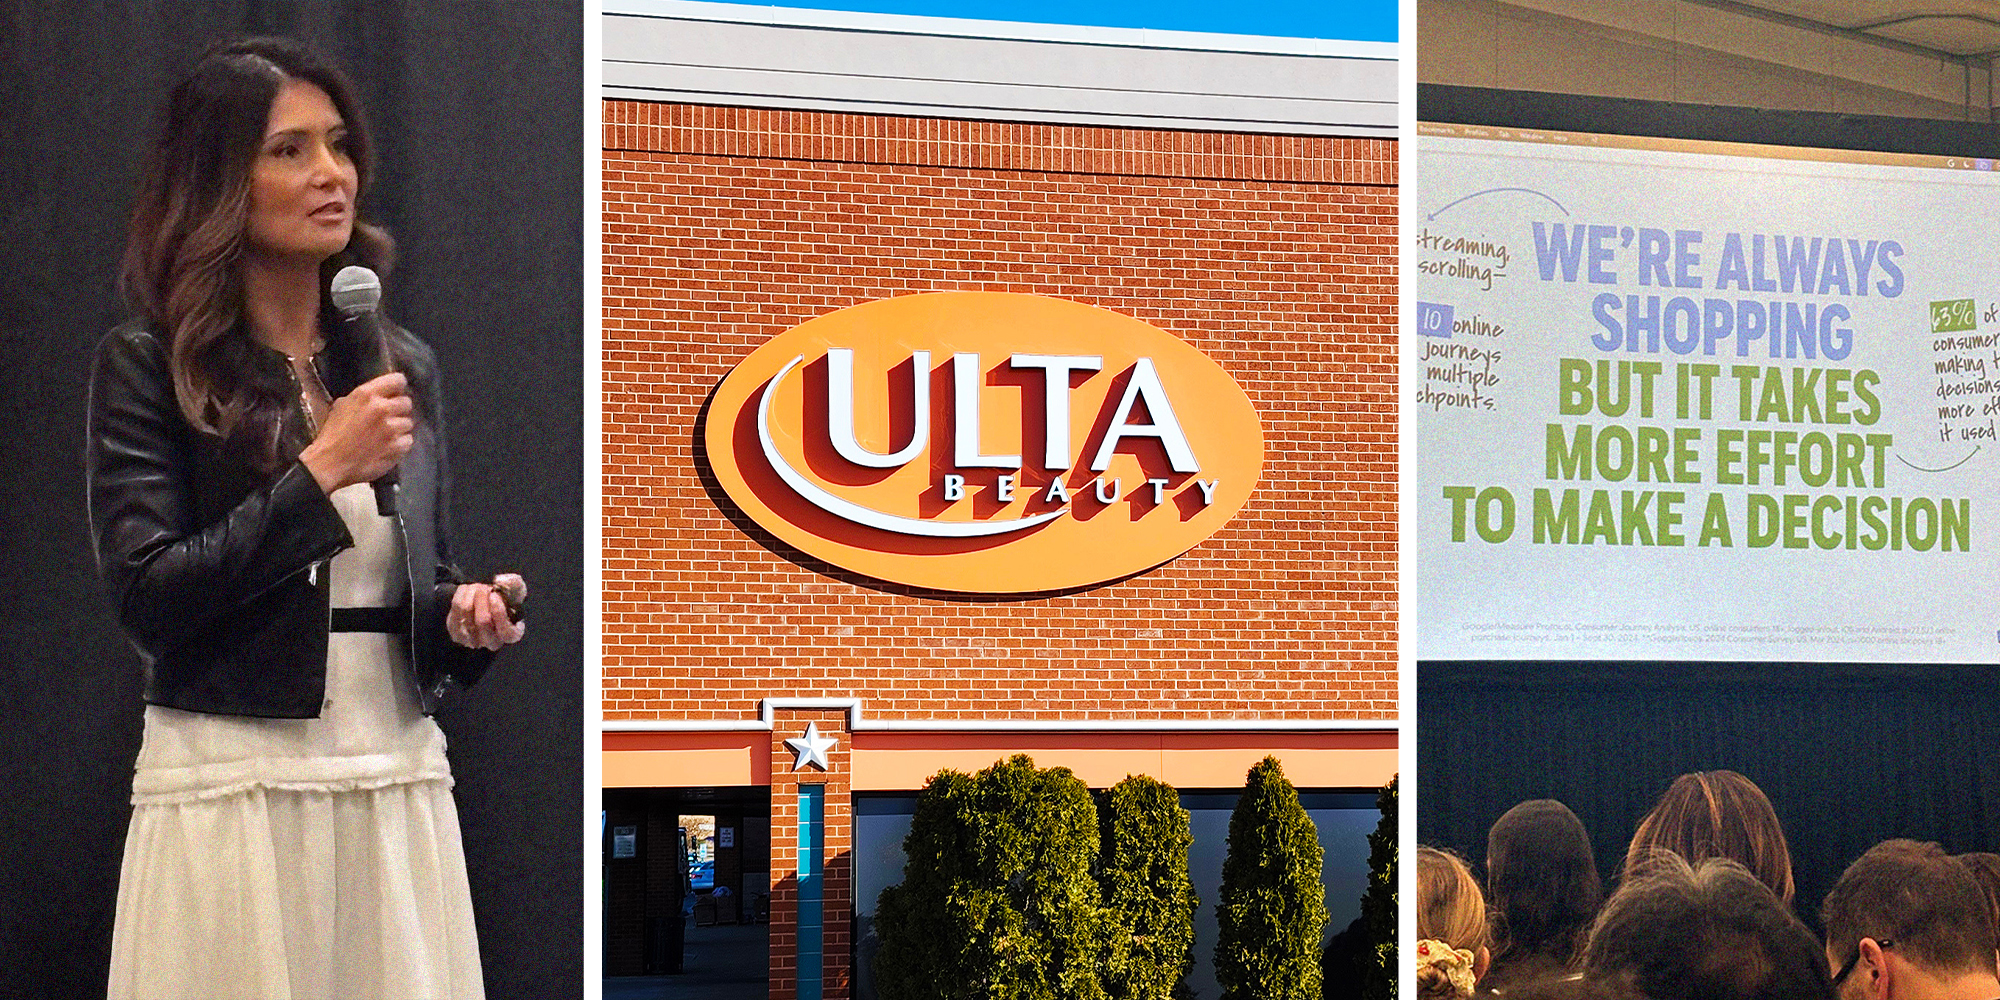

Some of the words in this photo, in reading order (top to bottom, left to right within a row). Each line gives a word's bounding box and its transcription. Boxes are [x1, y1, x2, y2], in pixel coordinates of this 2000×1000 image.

[1715, 232, 1905, 299] ALWAYS
[1424, 308, 1441, 330] 10
[1453, 314, 1504, 337] online
[1590, 292, 1853, 361] SHOPPING
[1932, 301, 1975, 331] 63%
[1985, 303, 1999, 323] of
[1421, 335, 1501, 371] journeys
[1933, 333, 2000, 351] consumer
[1427, 363, 1499, 392] multiple
[1935, 352, 1986, 380] making
[1559, 358, 1662, 418] BUT
[1677, 363, 1719, 419] IT
[1732, 366, 1882, 426] TAKES
[1937, 374, 2000, 400] decisions
[828, 347, 1201, 473] ULTA
[1938, 404, 1975, 419] more
[1939, 421, 1953, 442] it
[1961, 419, 1996, 441] used
[1546, 424, 1701, 484] MORE
[1717, 430, 1893, 488] EFFORT
[944, 474, 1220, 505] BEAUTY
[1443, 486, 1516, 544] TO
[1533, 488, 1684, 547] MAKE
[1699, 493, 1732, 548] A
[1747, 494, 1970, 552] DECISION
